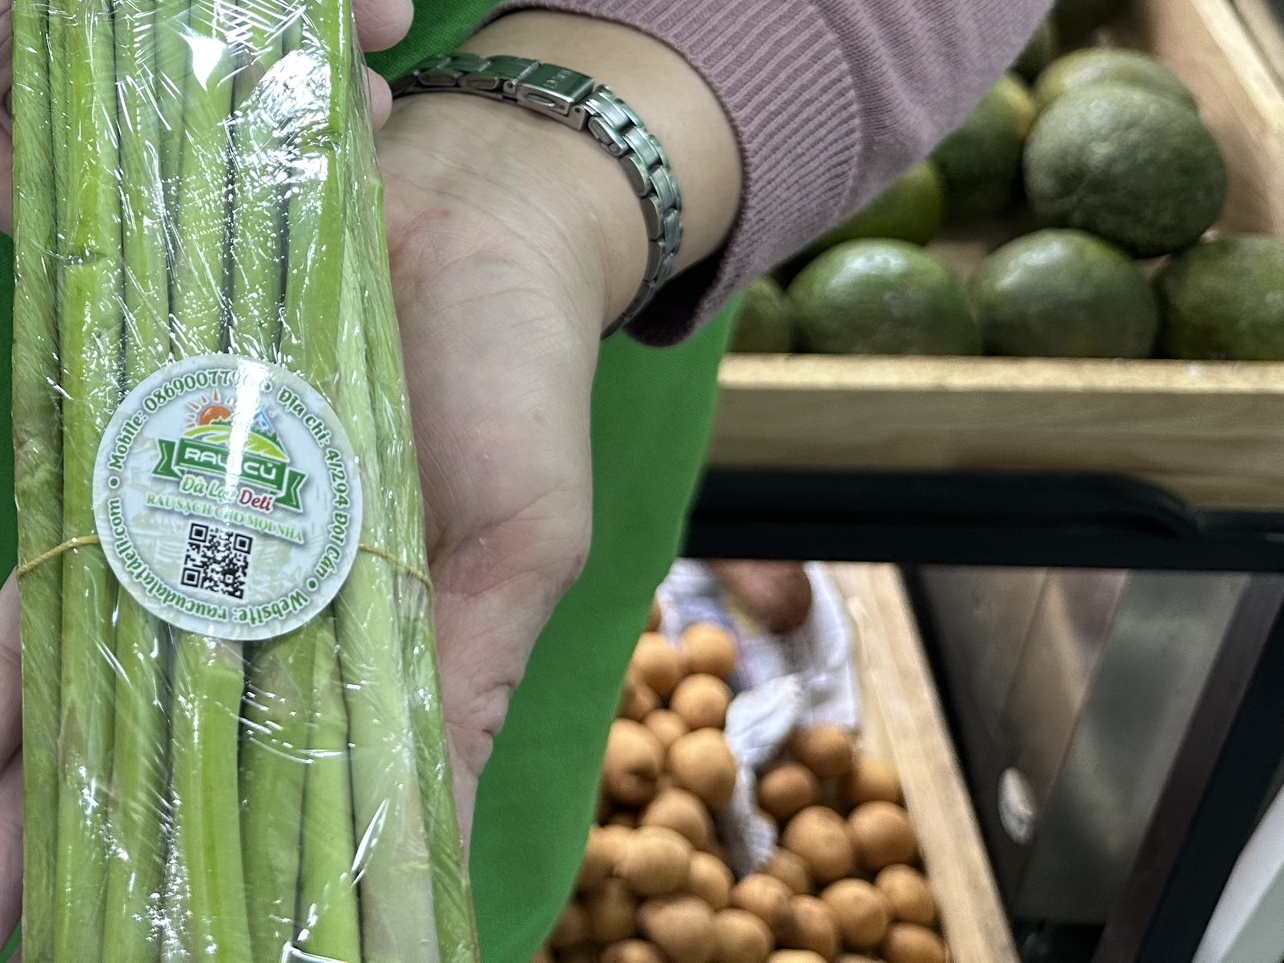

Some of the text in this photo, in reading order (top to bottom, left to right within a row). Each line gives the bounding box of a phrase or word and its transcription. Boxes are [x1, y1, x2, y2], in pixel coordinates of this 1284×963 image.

[109, 410, 148, 470] Mobile:
[277, 387, 305, 416] Địa
[325, 449, 349, 508] 4/294
[239, 488, 274, 512] Deli
[243, 462, 277, 480] CỦ
[109, 498, 309, 625] Website: raucudalatdeli.com
